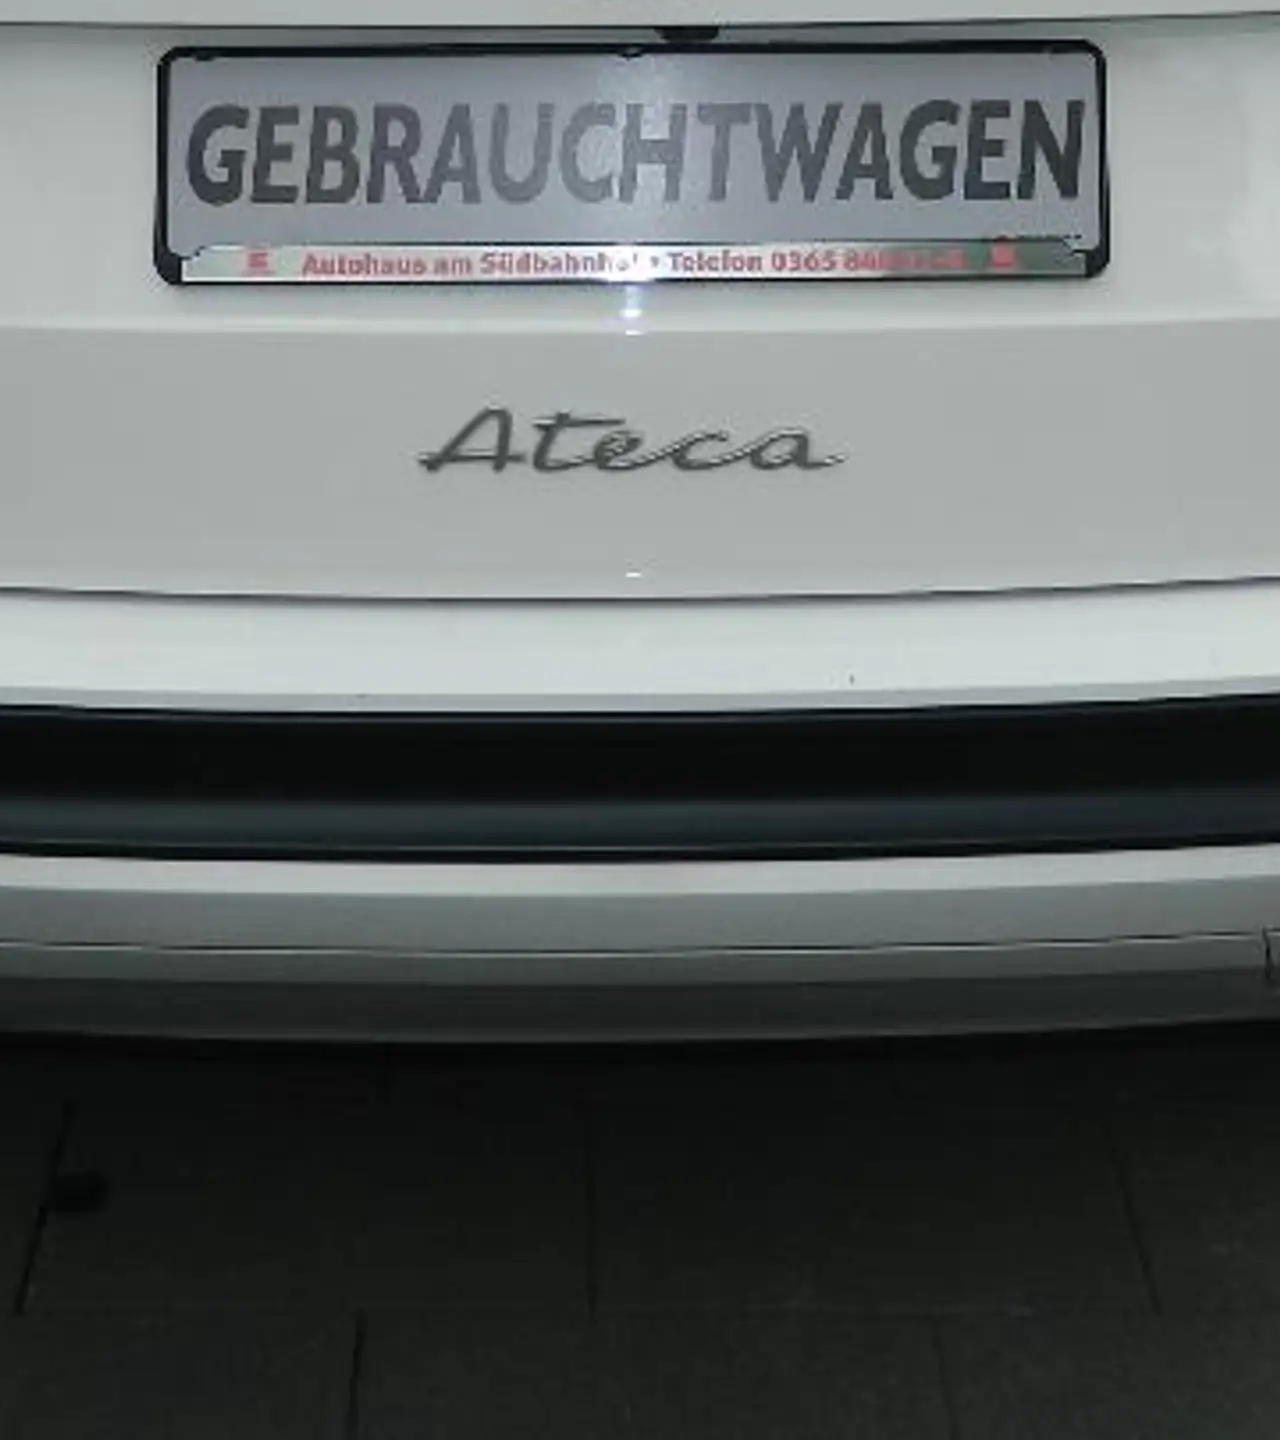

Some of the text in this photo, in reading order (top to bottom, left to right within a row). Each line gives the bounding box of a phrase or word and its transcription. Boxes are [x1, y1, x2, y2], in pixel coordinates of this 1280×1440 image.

[186, 98, 1086, 207] GEBRAUCHTWAGEN
[301, 251, 426, 276] Autohaus
[431, 255, 472, 274] am
[666, 249, 763, 273] Telefon
[770, 248, 837, 272] 0365
[417, 404, 850, 473] Ateca
